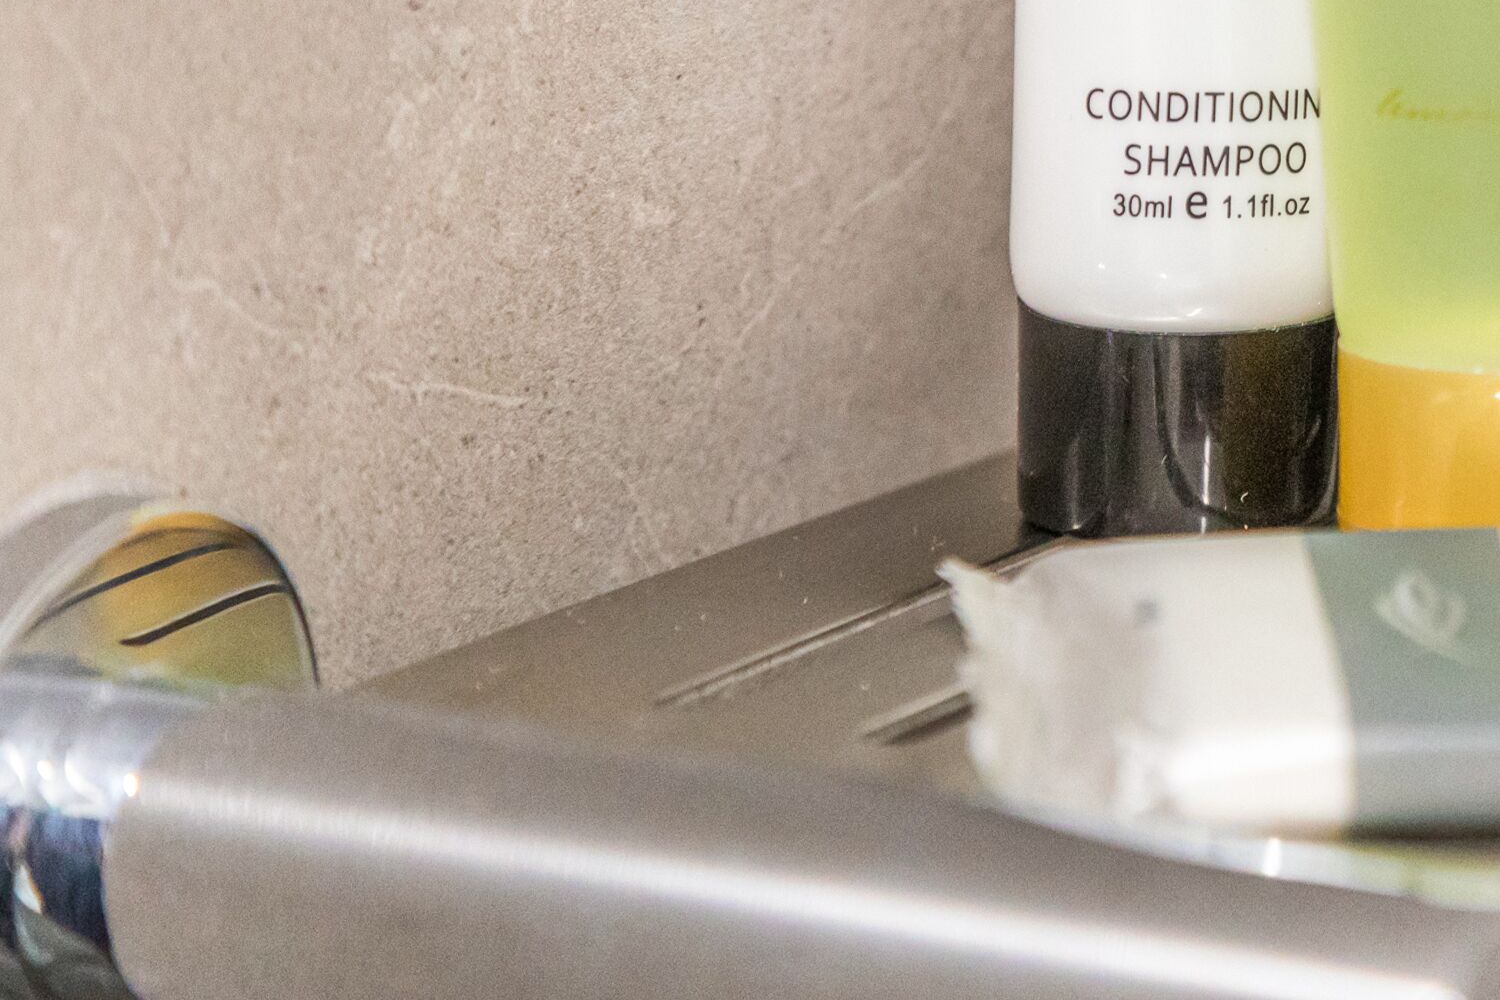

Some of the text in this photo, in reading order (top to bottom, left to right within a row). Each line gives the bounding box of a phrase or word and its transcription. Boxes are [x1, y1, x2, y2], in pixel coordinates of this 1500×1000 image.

[1086, 87, 1320, 123] CONDITIONIN
[1123, 141, 1307, 176] SHAMPOO
[1112, 192, 1173, 219] 30ml
